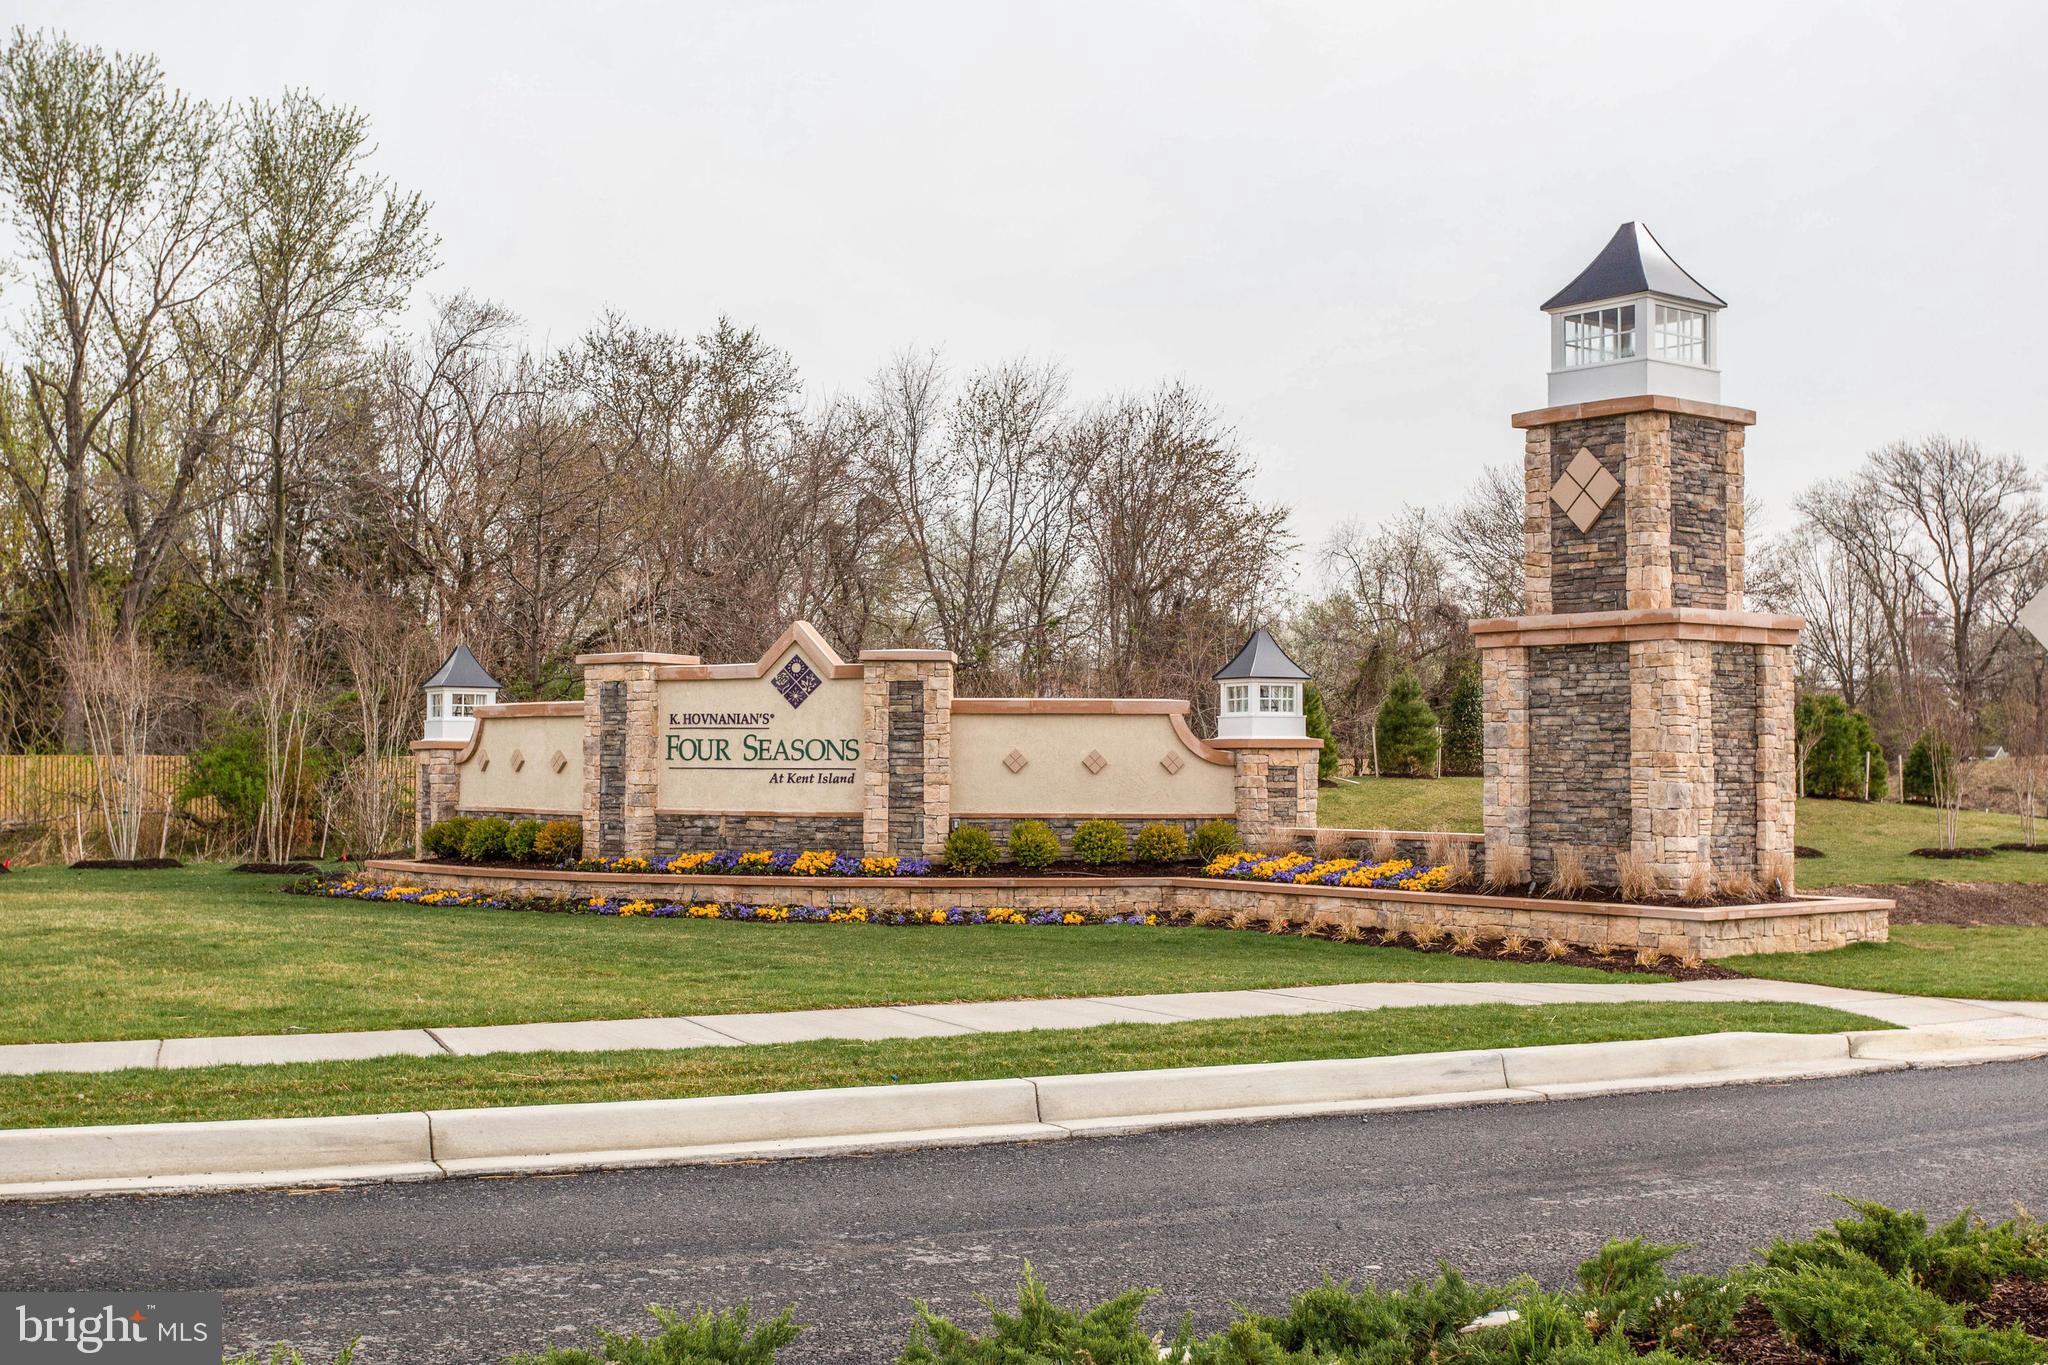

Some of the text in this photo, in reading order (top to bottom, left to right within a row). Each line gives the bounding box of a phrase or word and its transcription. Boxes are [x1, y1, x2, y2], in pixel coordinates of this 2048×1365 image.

[669, 713, 680, 725] K.
[665, 734, 860, 761] FOUR SEASONS
[769, 773, 855, 784] At Kent Island
